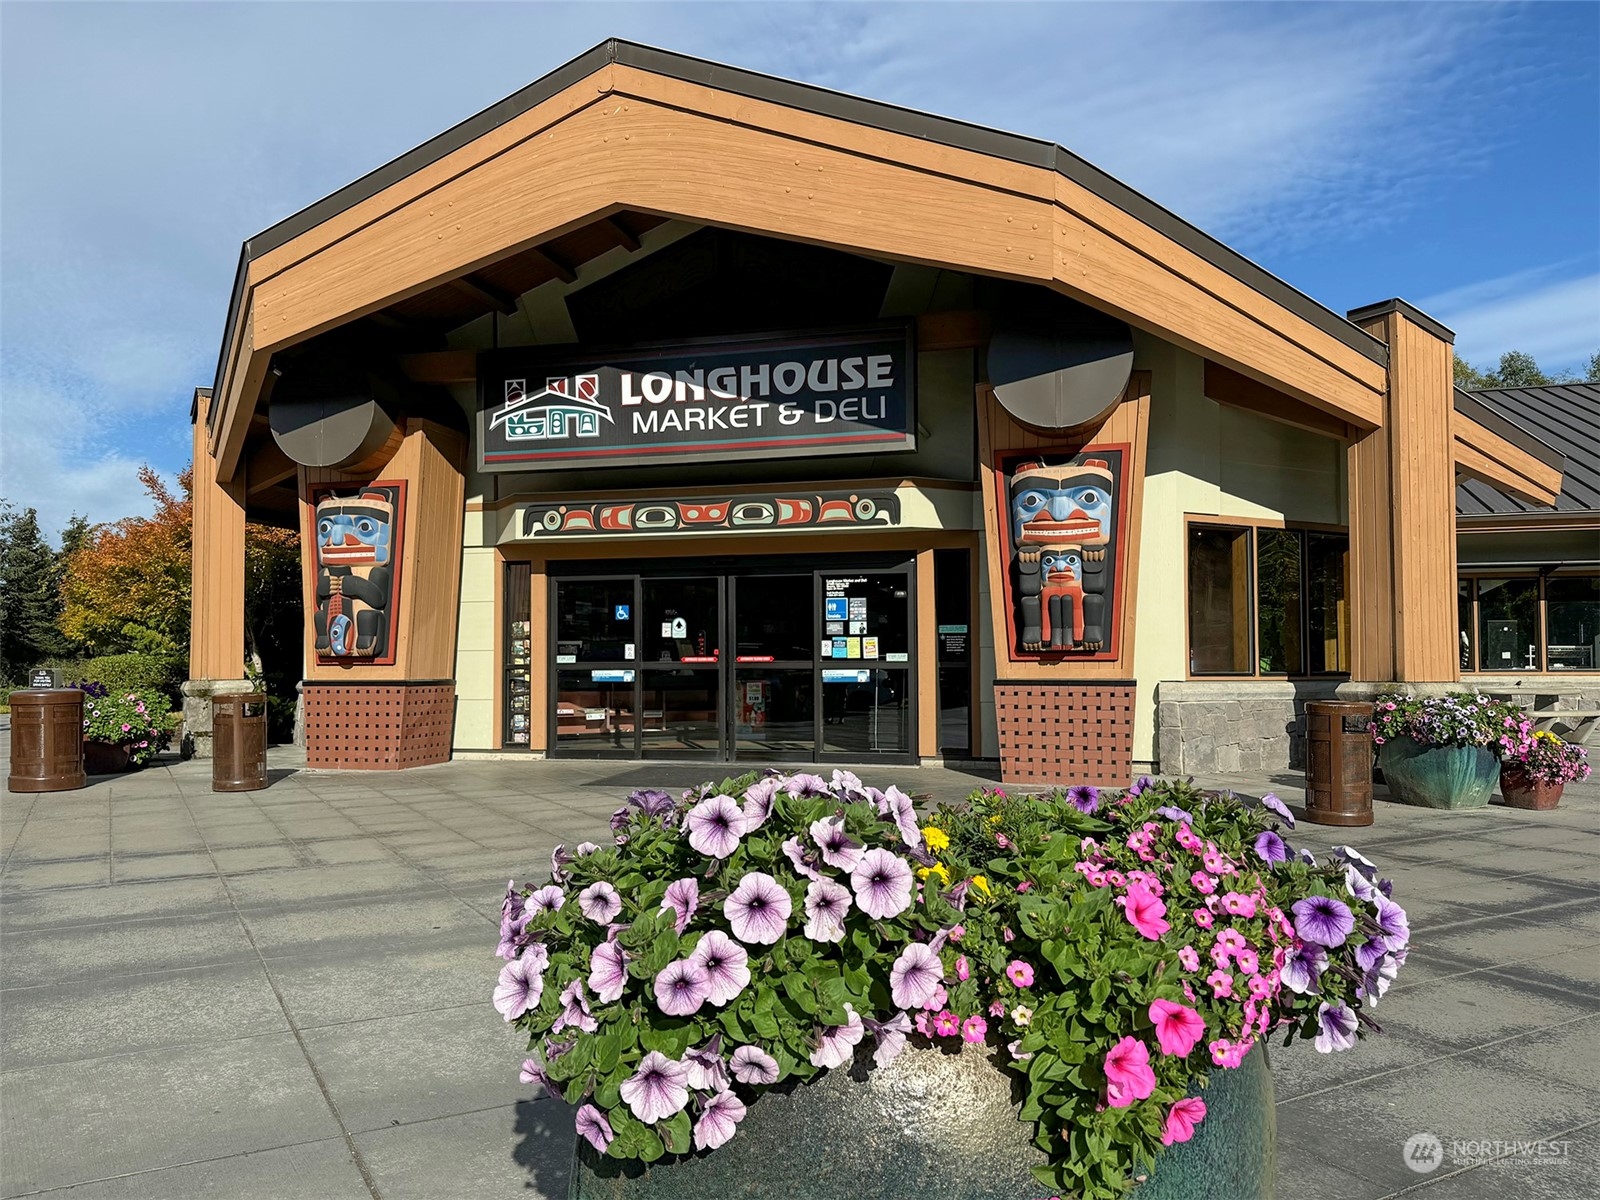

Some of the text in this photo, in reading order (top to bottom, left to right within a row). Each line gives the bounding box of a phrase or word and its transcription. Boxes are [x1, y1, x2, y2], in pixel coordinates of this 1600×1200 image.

[620, 354, 896, 406] LONGHOUSE
[632, 395, 886, 434] MARKET & DELI
